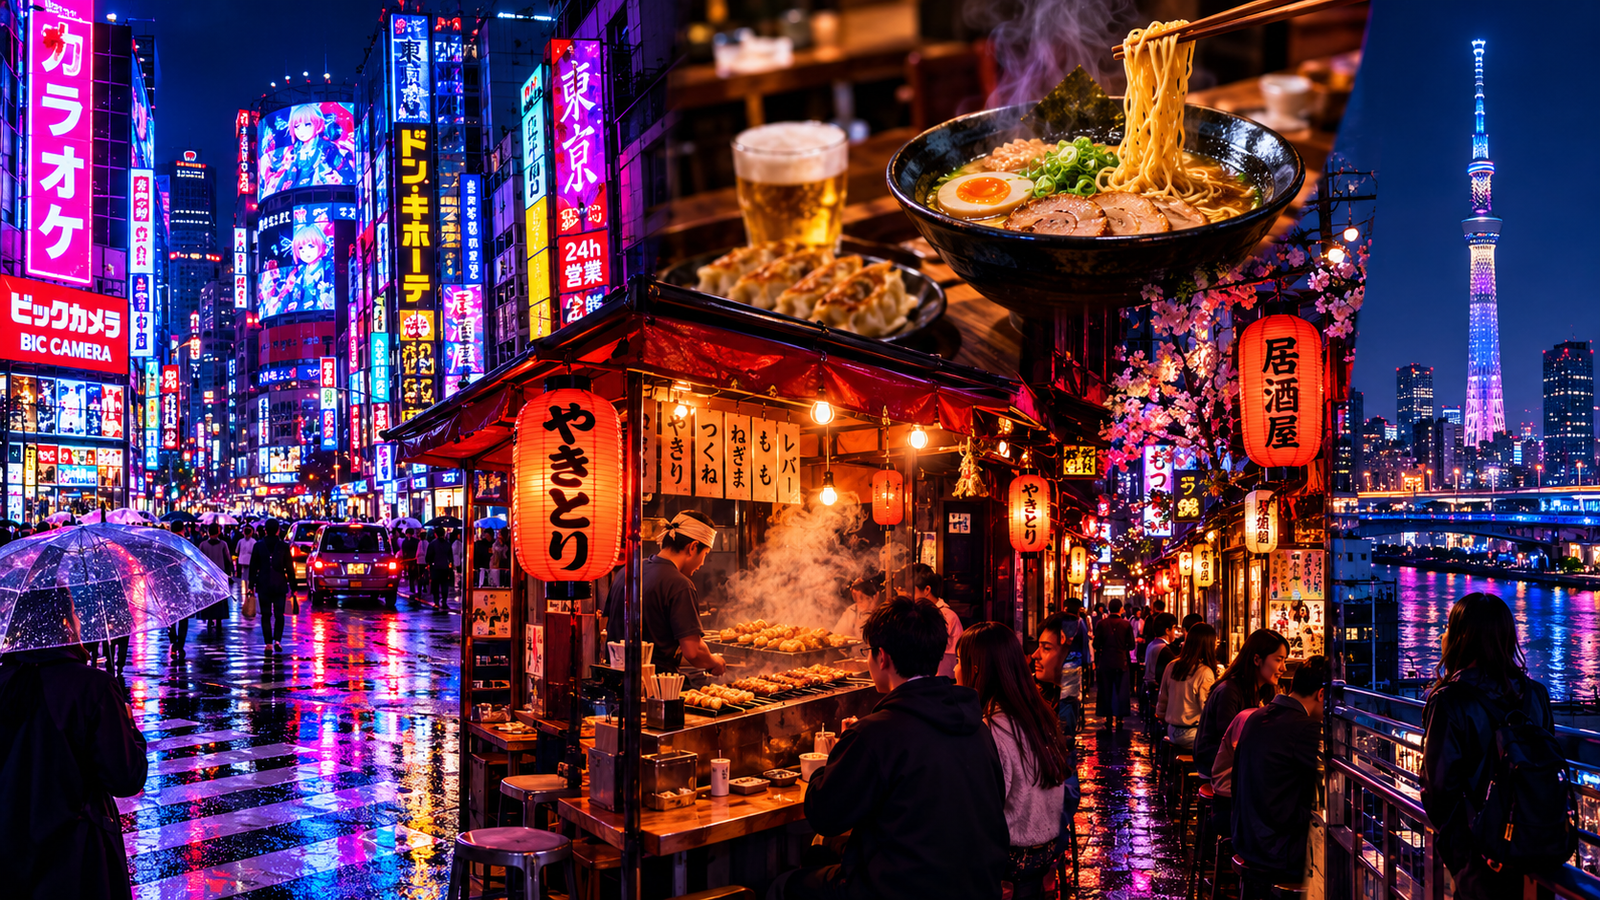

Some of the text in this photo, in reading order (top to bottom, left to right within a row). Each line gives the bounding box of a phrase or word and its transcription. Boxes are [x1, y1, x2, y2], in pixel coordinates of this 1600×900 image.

[40, 22, 84, 260] カラオケ
[559, 60, 598, 194] 東京
[401, 129, 431, 303] ドン・キホーテ
[564, 259, 603, 288] 営業
[565, 239, 601, 262] 24h
[11, 292, 121, 339] ビックカメラ
[20, 332, 113, 362] BIC CAMERA
[1262, 336, 1300, 450] 居酒屋
[667, 415, 685, 484] やきり
[701, 423, 718, 484] つくね
[731, 425, 746, 489] ねぎま
[758, 430, 772, 486] もも
[781, 433, 797, 494] レバー
[542, 402, 596, 571] やきとり
[1021, 483, 1039, 546] やきとり
